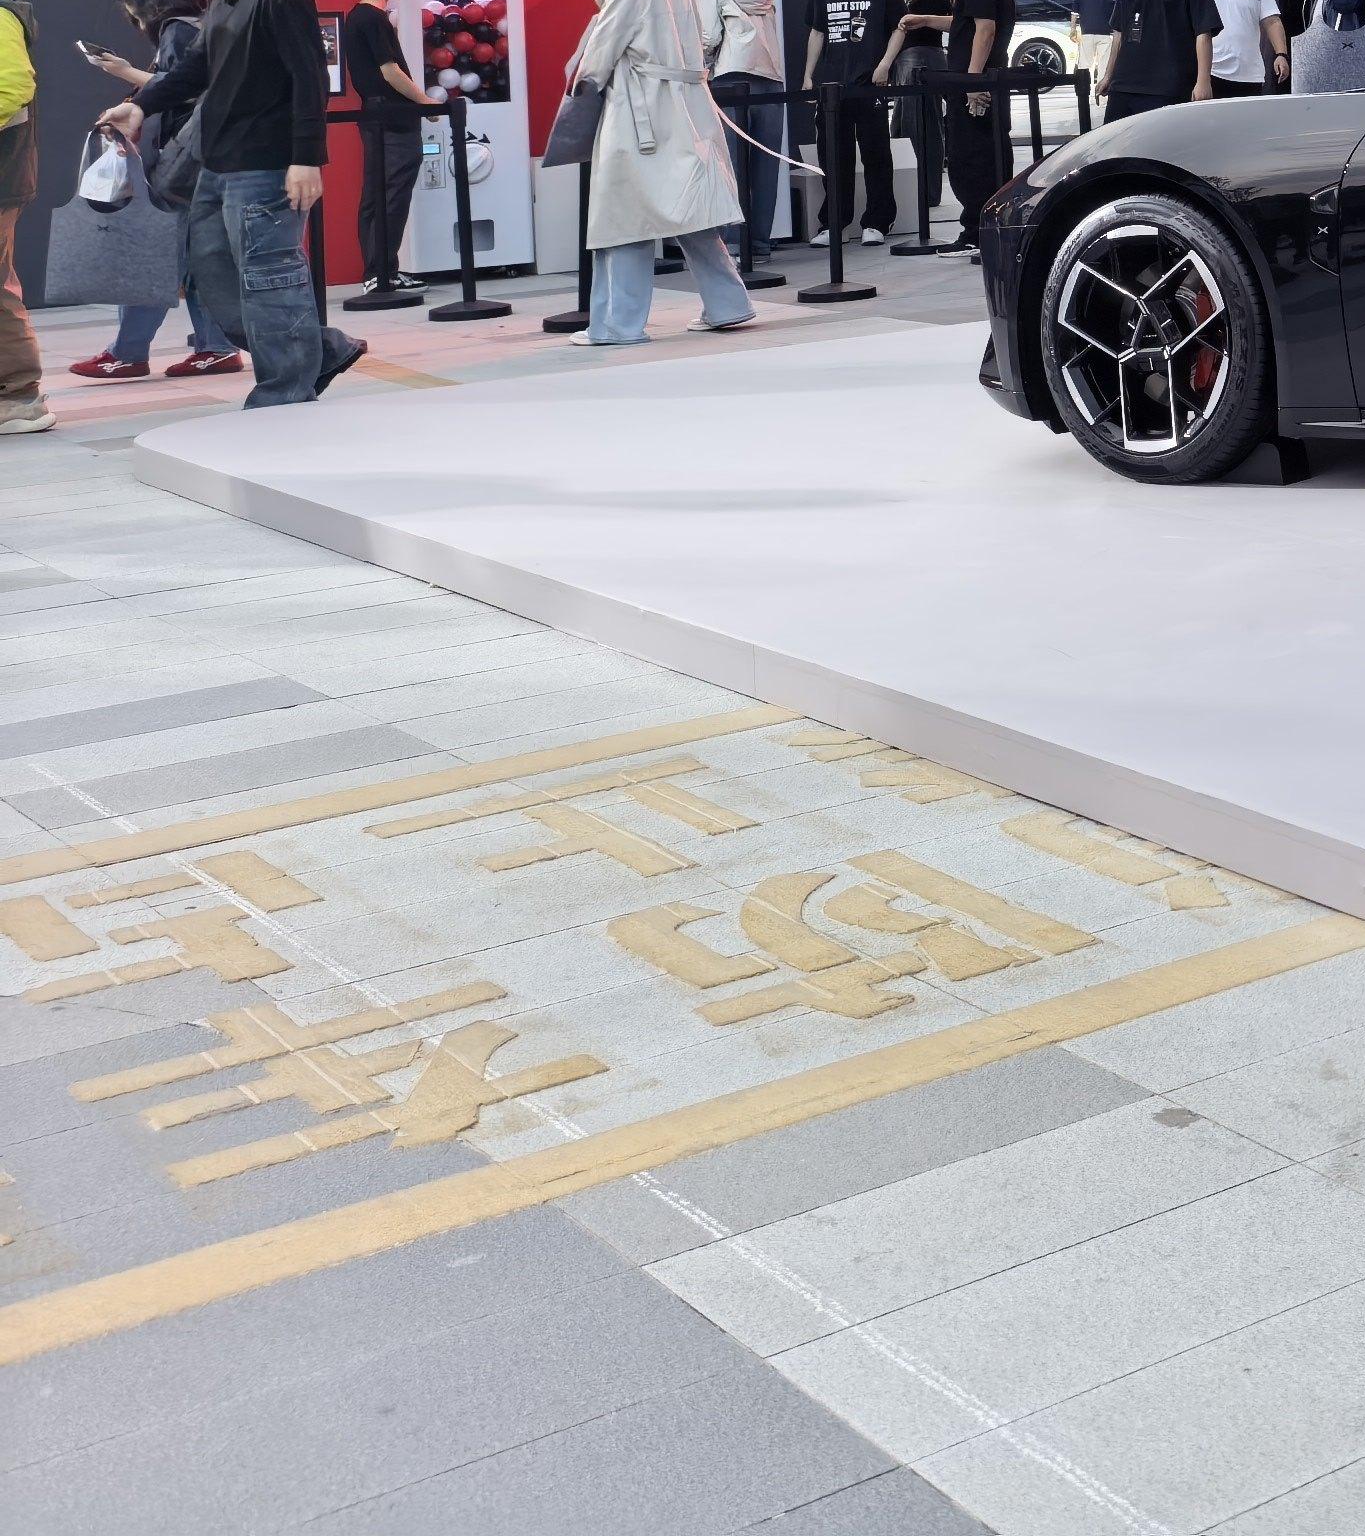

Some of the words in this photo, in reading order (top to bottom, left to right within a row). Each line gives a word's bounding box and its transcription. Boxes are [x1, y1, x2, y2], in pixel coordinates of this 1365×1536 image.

[826, 1, 849, 13] DON'T
[849, 0, 871, 11] STOP
[0, 809, 1302, 1247] 防车
